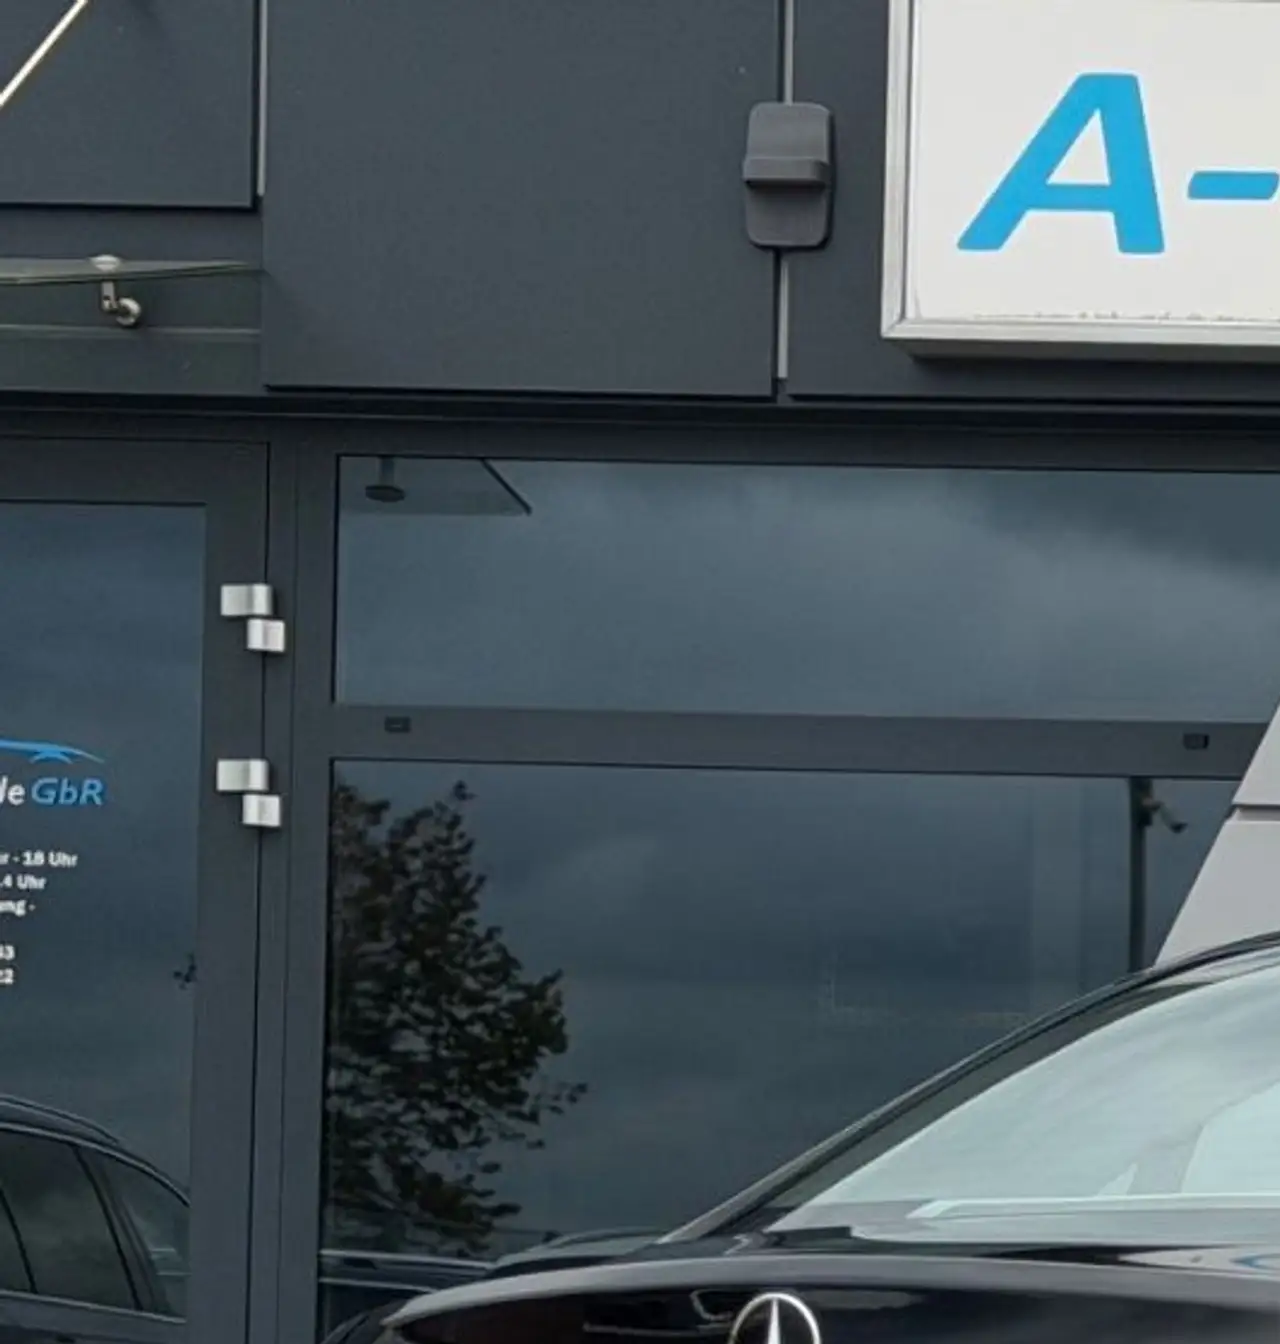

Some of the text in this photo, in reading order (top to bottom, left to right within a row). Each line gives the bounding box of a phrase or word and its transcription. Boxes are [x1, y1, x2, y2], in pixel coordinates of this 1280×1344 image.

[31, 776, 104, 806] GbR
[48, 850, 79, 868] Uhr
[16, 873, 47, 890] Uhr
